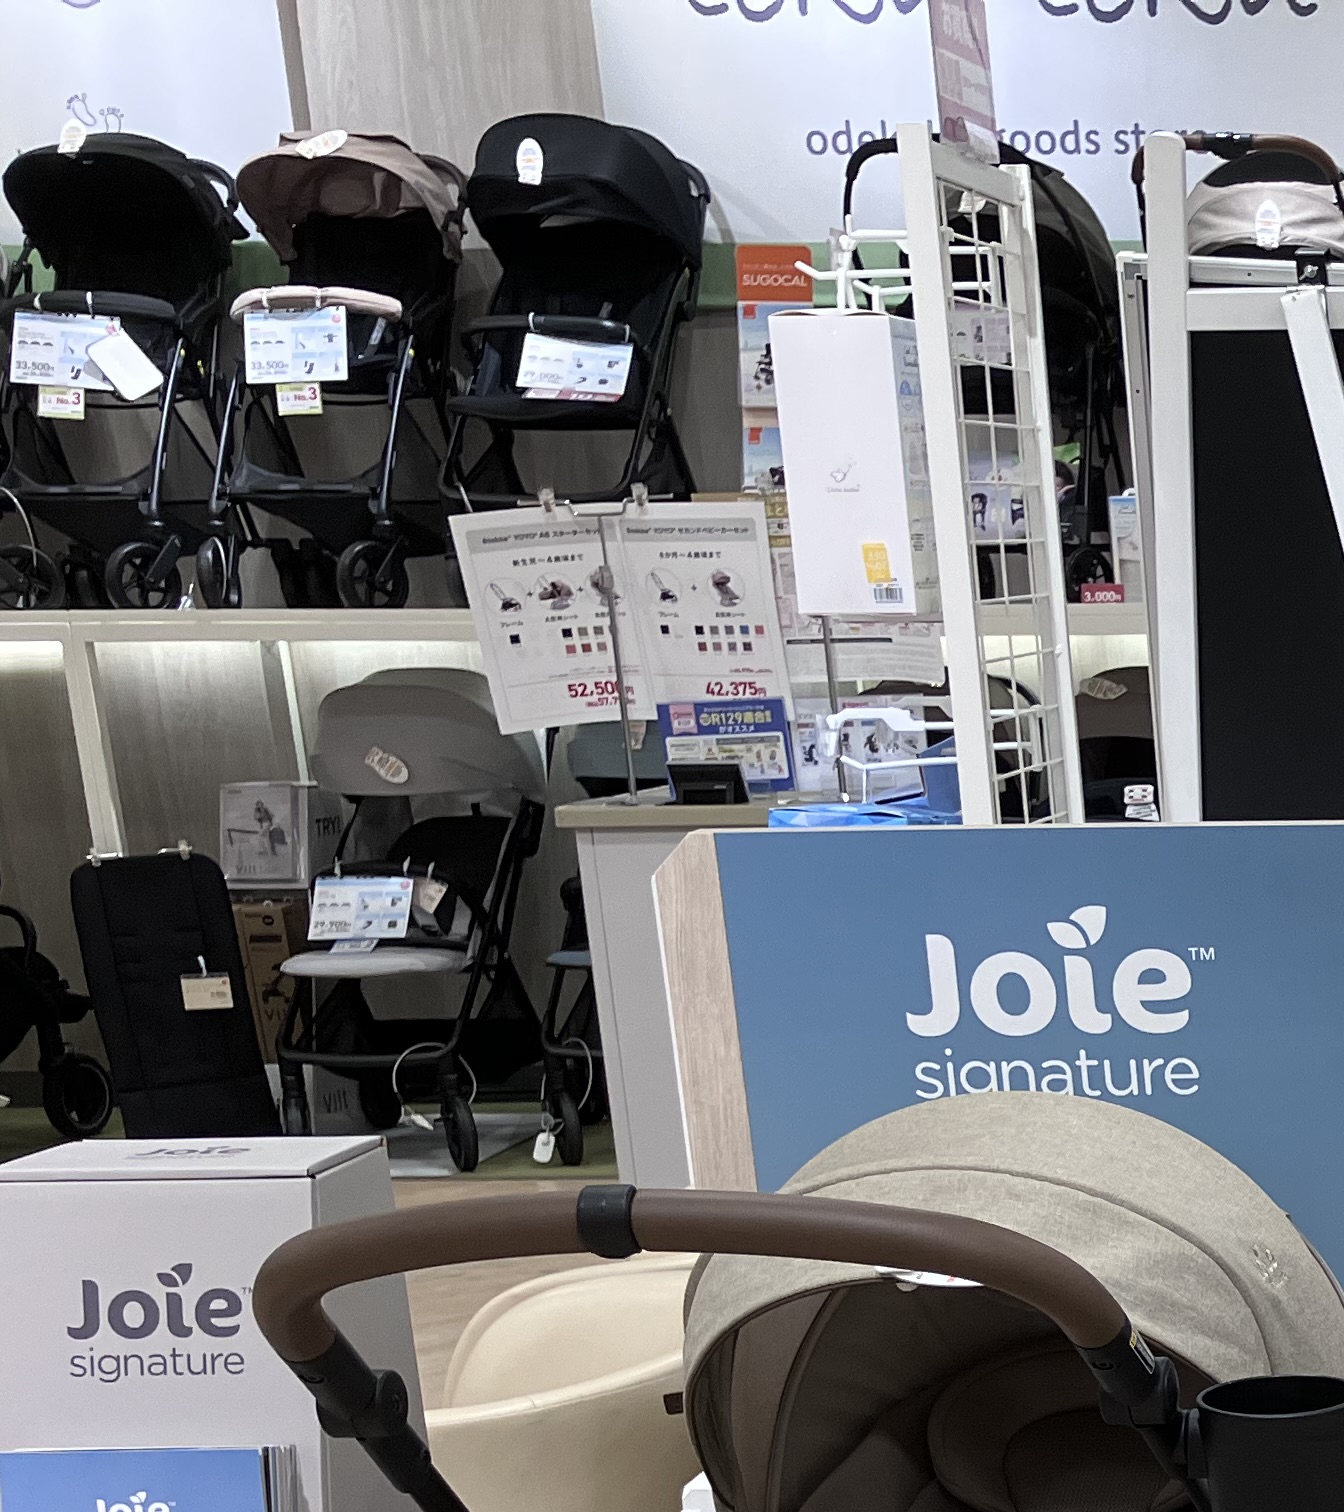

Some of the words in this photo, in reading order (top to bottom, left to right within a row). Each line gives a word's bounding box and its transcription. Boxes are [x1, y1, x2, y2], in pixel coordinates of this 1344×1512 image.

[742, 274, 807, 288] SUGOCAL
[906, 905, 1192, 1037] Joie
[915, 1049, 1200, 1099] signature
[66, 1262, 244, 1341] Joie
[69, 1347, 245, 1383] signature
